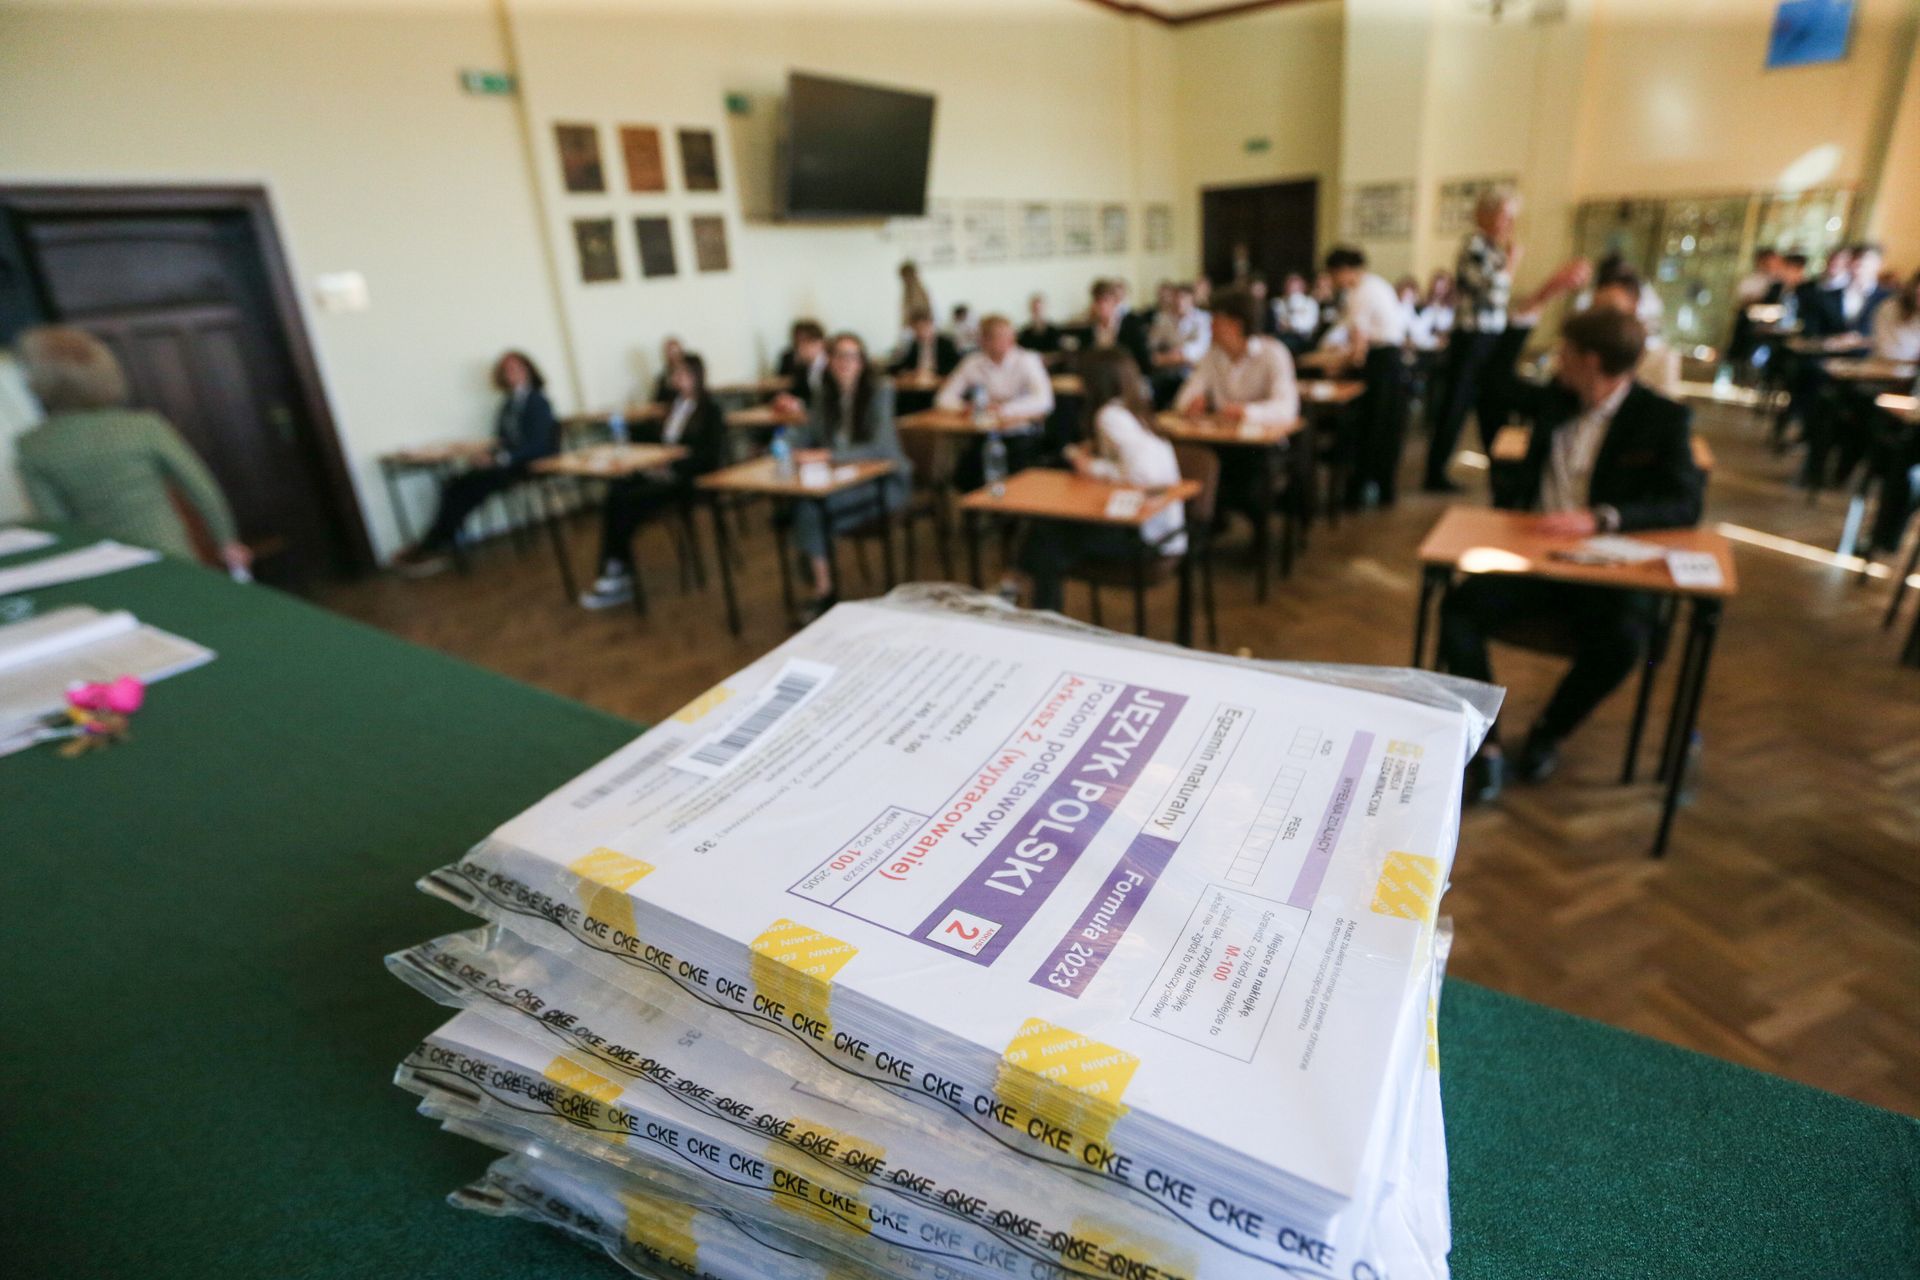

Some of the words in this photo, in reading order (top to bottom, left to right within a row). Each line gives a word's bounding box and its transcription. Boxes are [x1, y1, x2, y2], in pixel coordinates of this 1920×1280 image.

[1028, 675, 1089, 728] Arkusz
[1055, 682, 1117, 739] Poziom
[1013, 730, 1043, 746] 2.
[1072, 688, 1171, 779] JĘZYK
[1194, 707, 1244, 762] Egzamin
[954, 740, 1068, 848] podstawowy
[1151, 762, 1211, 830] maturalny
[874, 747, 1027, 883] (wypracowanie)
[879, 816, 922, 849] Symbol
[1280, 815, 1302, 842] PESEL
[691, 839, 719, 855] 35
[982, 778, 1107, 897] POLSKI
[839, 847, 884, 882] arkusza
[1079, 869, 1145, 942] Formuła
[943, 918, 982, 942] 2
[970, 926, 996, 951] ARKUSZ
[1184, 932, 1206, 954] zgłoś
[1209, 927, 1224, 940] tak
[1044, 941, 1095, 989] 2023
[1187, 946, 1213, 978] przyklej
[1242, 944, 1257, 959] czy
[1260, 932, 1285, 966] Miejsce
[1236, 960, 1252, 977] kod
[1256, 966, 1269, 978] na
[1211, 988, 1239, 1026] naklejce
[430, 1048, 455, 1067] CKE
[460, 1059, 487, 1080] CKE
[514, 988, 545, 1013] CKE
[717, 1097, 754, 1122] CKE
[757, 1114, 796, 1140] CKE
[800, 1131, 839, 1158] CKE
[846, 1149, 887, 1177] CKE
[894, 1169, 936, 1198] CKE
[943, 1188, 988, 1217] CKE
[583, 916, 609, 939] CKE
[613, 930, 640, 954] CKE
[645, 945, 673, 970] CKE
[679, 960, 709, 986] CKE
[716, 977, 748, 1004] CKE
[753, 994, 785, 1022] CKE
[792, 1012, 827, 1042] CKE
[834, 1032, 869, 1061] CKE
[875, 1051, 914, 1083] CKE
[922, 1072, 964, 1105] CKE
[973, 1094, 1017, 1129] CKE
[1027, 1117, 1073, 1154] CKE
[1083, 1142, 1133, 1181] CKE
[1144, 1168, 1197, 1209] CKE
[1208, 1197, 1264, 1239] CKE
[1277, 1227, 1336, 1270] CKE
[608, 1109, 639, 1131] CKE
[647, 1122, 679, 1147] CKE
[687, 1137, 720, 1163] CKE
[729, 1153, 764, 1180] CKE
[773, 1169, 809, 1197] CKE
[819, 1188, 858, 1215] CKE
[868, 1204, 909, 1234] CKE
[919, 1222, 963, 1250] CKE
[973, 1240, 1019, 1273] CKE
